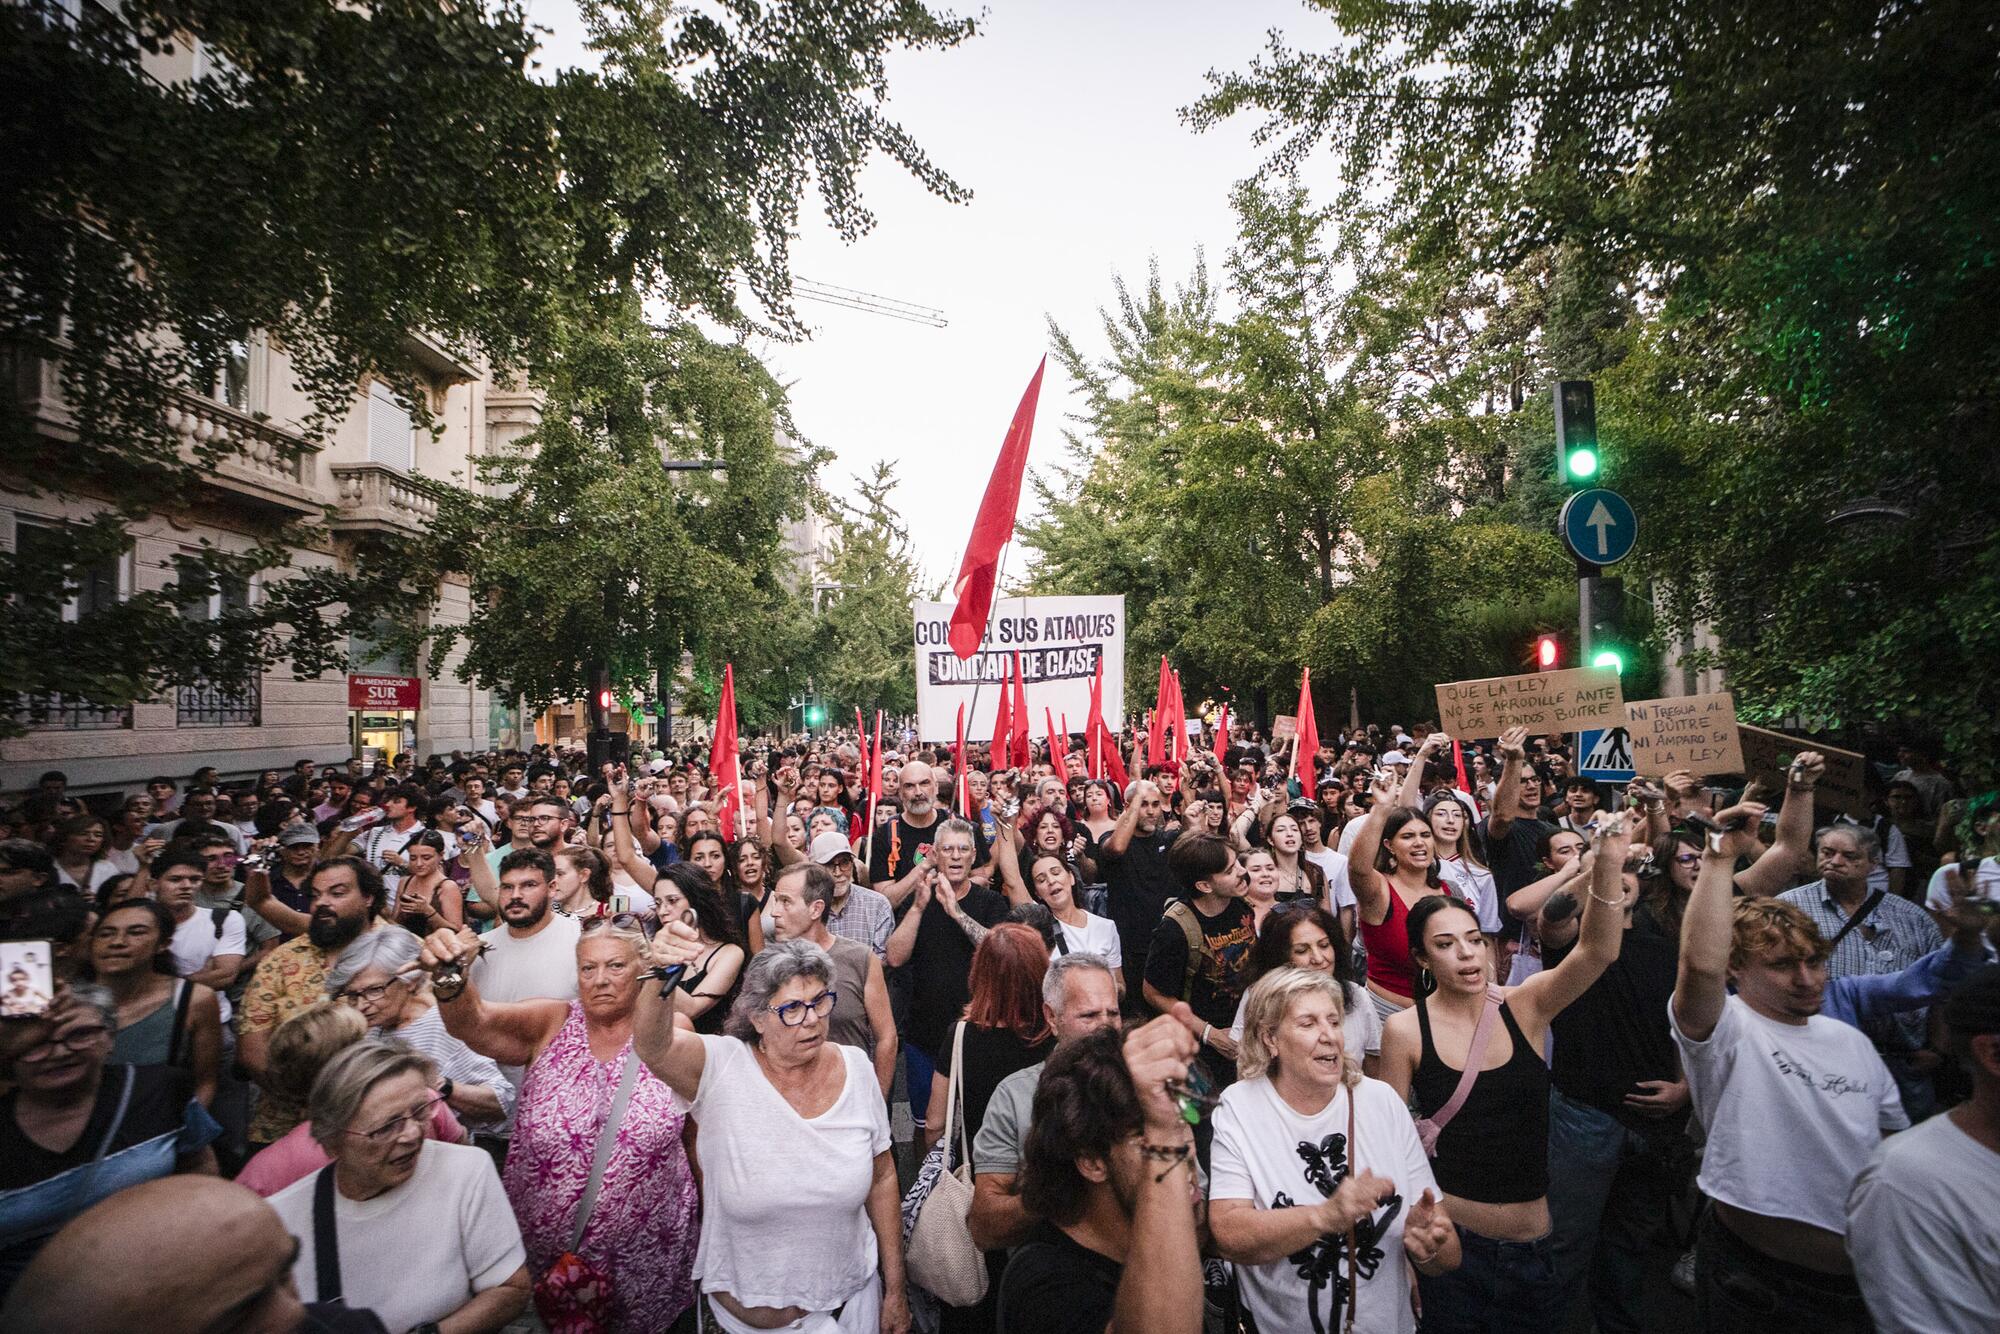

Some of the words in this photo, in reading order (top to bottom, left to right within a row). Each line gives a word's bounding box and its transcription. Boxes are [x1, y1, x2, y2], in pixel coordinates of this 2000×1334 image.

[999, 617, 1039, 644] SUS
[1043, 613, 1116, 643] ATAQUES
[1046, 647, 1097, 677] CLASE
[355, 677, 409, 687] ALIMENTACIÓN
[367, 686, 397, 699] SUR
[1446, 685, 1480, 701] QUE
[1488, 684, 1508, 698] LA
[1517, 678, 1549, 693] LEY
[1445, 705, 1462, 718] NO
[1468, 702, 1485, 714] SE
[1492, 691, 1565, 712] ARRODILLE
[1576, 686, 1616, 703] ANTE
[1630, 707, 1648, 721] NI
[1650, 704, 1696, 719] TREGUA
[1706, 702, 1723, 712] AL
[1458, 718, 1485, 730] LOS
[1497, 711, 1545, 726] FONDOS
[1554, 702, 1613, 721] BUITRE
[1634, 736, 1650, 749] NI
[1656, 734, 1706, 747] AMPARO
[1654, 751, 1675, 765] LA
[1689, 746, 1728, 762] LEY
